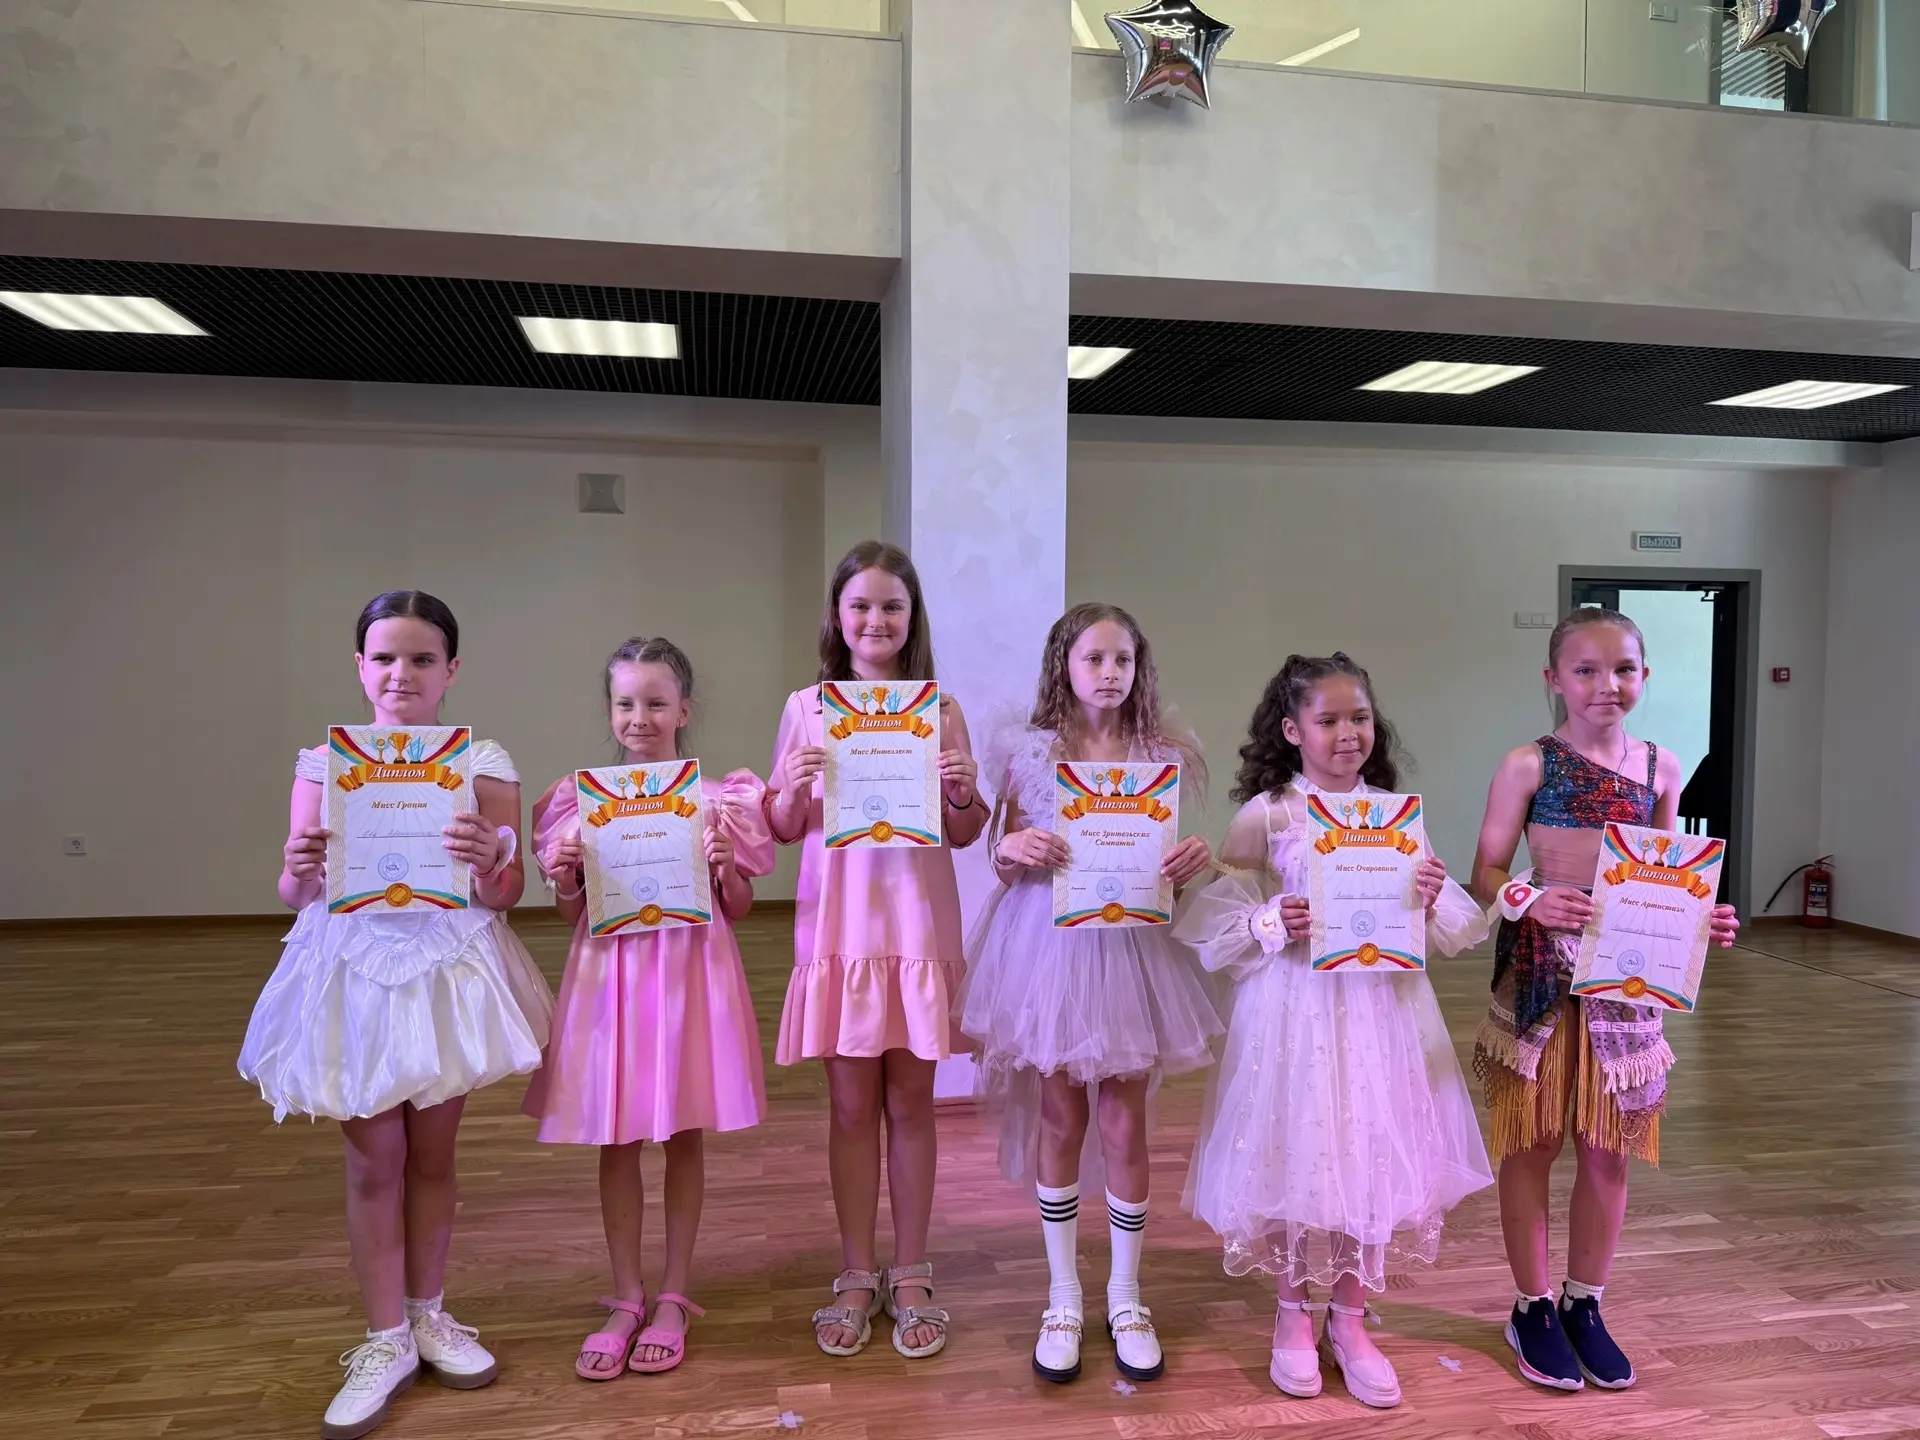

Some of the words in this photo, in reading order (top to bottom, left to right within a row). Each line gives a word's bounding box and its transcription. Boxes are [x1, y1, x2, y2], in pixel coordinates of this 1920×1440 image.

[1641, 537, 1679, 548] ВЫХОД
[856, 717, 903, 730] Диплом
[850, 748, 869, 756] Мисс
[370, 766, 427, 781] Диплом
[371, 801, 394, 809] Мисс
[396, 801, 428, 811] Грация
[615, 800, 665, 815] Диплом
[1089, 799, 1139, 812] Диплом
[621, 832, 641, 841] Мисс
[642, 830, 667, 841] Лагерь
[1102, 830, 1150, 839] Зрительских
[1340, 831, 1388, 845] Диплом
[1095, 838, 1136, 847] Симпатий
[1335, 864, 1354, 872] Мисс
[1630, 866, 1680, 883] Диплом
[1504, 884, 1532, 907] 6
[1619, 896, 1640, 908] Мисс
[1641, 900, 1685, 913] Артистизм
